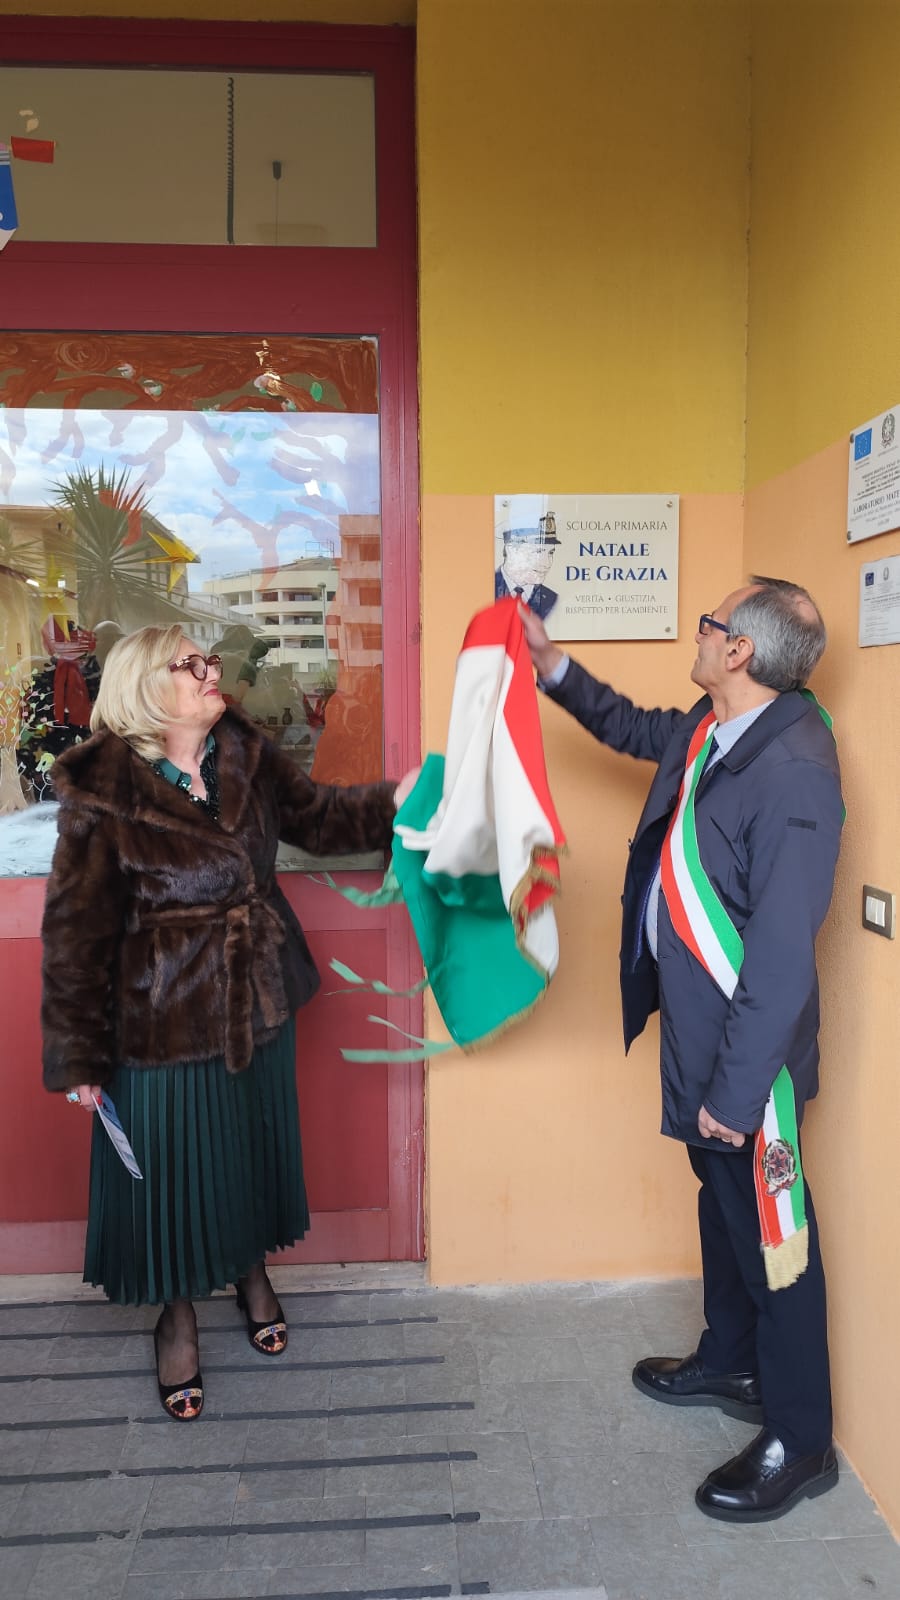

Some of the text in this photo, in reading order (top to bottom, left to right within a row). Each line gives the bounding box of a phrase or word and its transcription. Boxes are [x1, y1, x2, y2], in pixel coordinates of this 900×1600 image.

[566, 520, 668, 531] SCUOLA PRIMARIA
[579, 541, 650, 557] NATALE
[566, 565, 668, 581] DE GRAZIA
[614, 594, 656, 603] GIUSTIZIA
[565, 606, 603, 614] RISPETTO
[605, 606, 619, 614] PER
